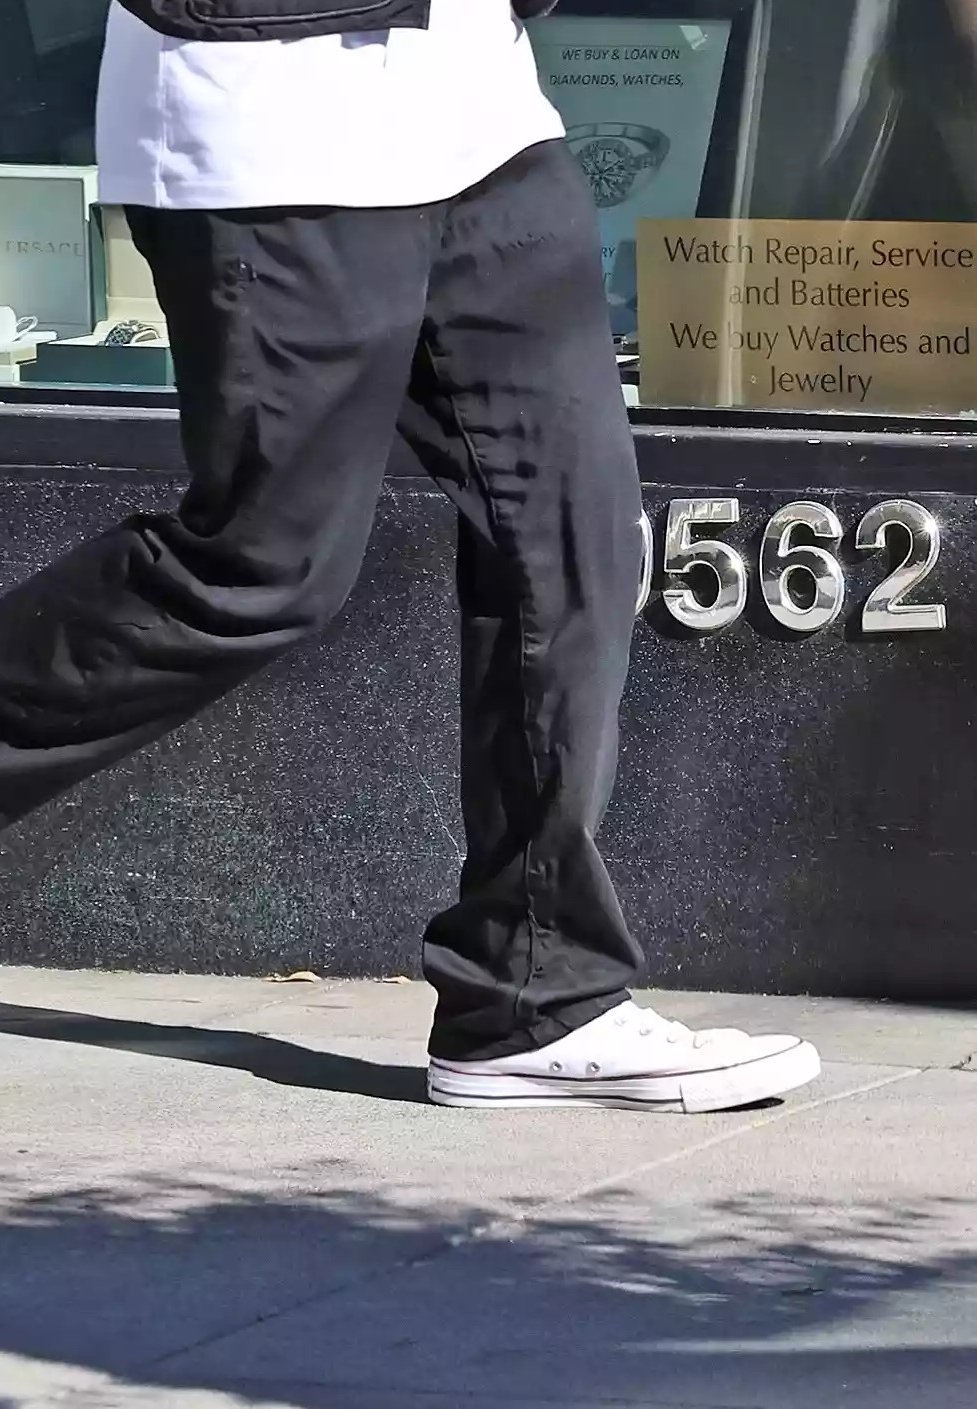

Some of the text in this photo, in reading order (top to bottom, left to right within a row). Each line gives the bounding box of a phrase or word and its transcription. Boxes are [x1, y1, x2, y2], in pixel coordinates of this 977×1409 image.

[561, 48, 680, 61] WE BUY & LOAN ON
[549, 74, 684, 87] DIAMONDS, WATCHES,
[664, 235, 974, 274] Watch Repair, Service
[729, 277, 910, 308] and Batteries
[669, 322, 970, 359] We buy Watches and
[768, 365, 873, 402] Jewelry
[635, 498, 947, 632] 562
